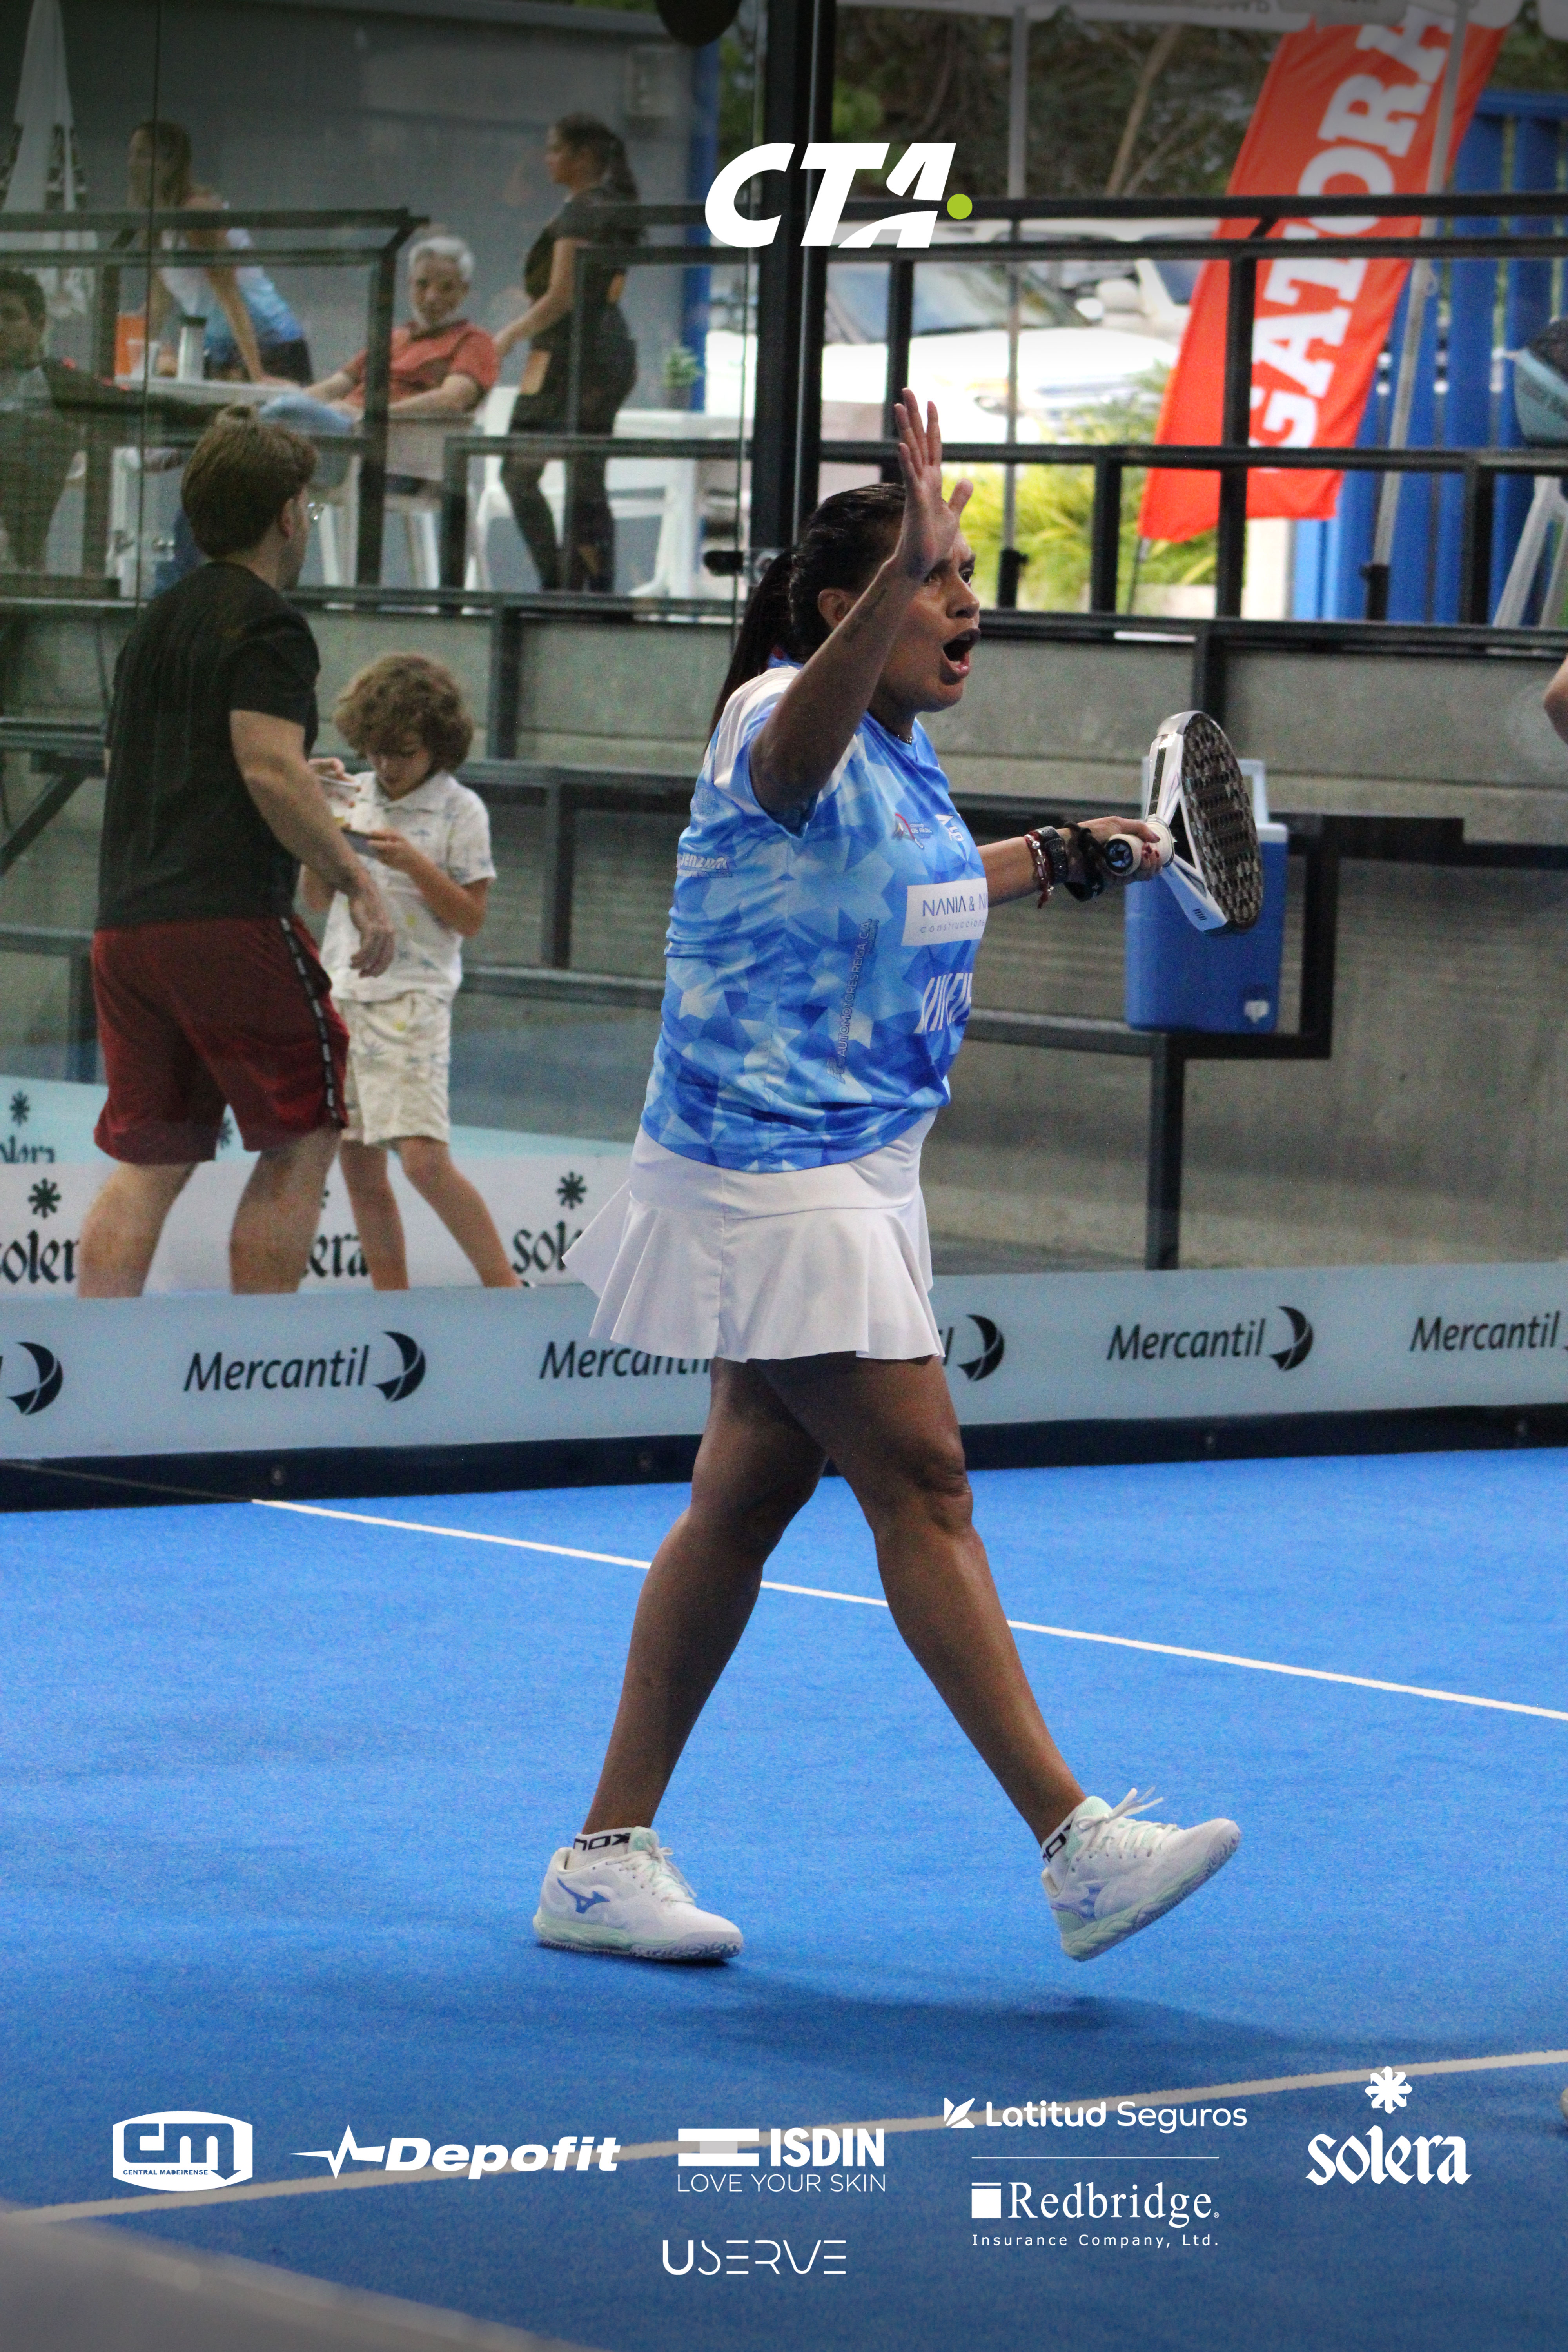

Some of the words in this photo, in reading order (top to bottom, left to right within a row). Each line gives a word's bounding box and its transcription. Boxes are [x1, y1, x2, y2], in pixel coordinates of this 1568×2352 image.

[922, 895, 966, 917] NANIA
[969, 896, 975, 912] &
[1106, 1318, 1266, 1360] Mercantil
[1410, 1310, 1560, 1352] Mercantil
[183, 1345, 370, 1392] Mercantil
